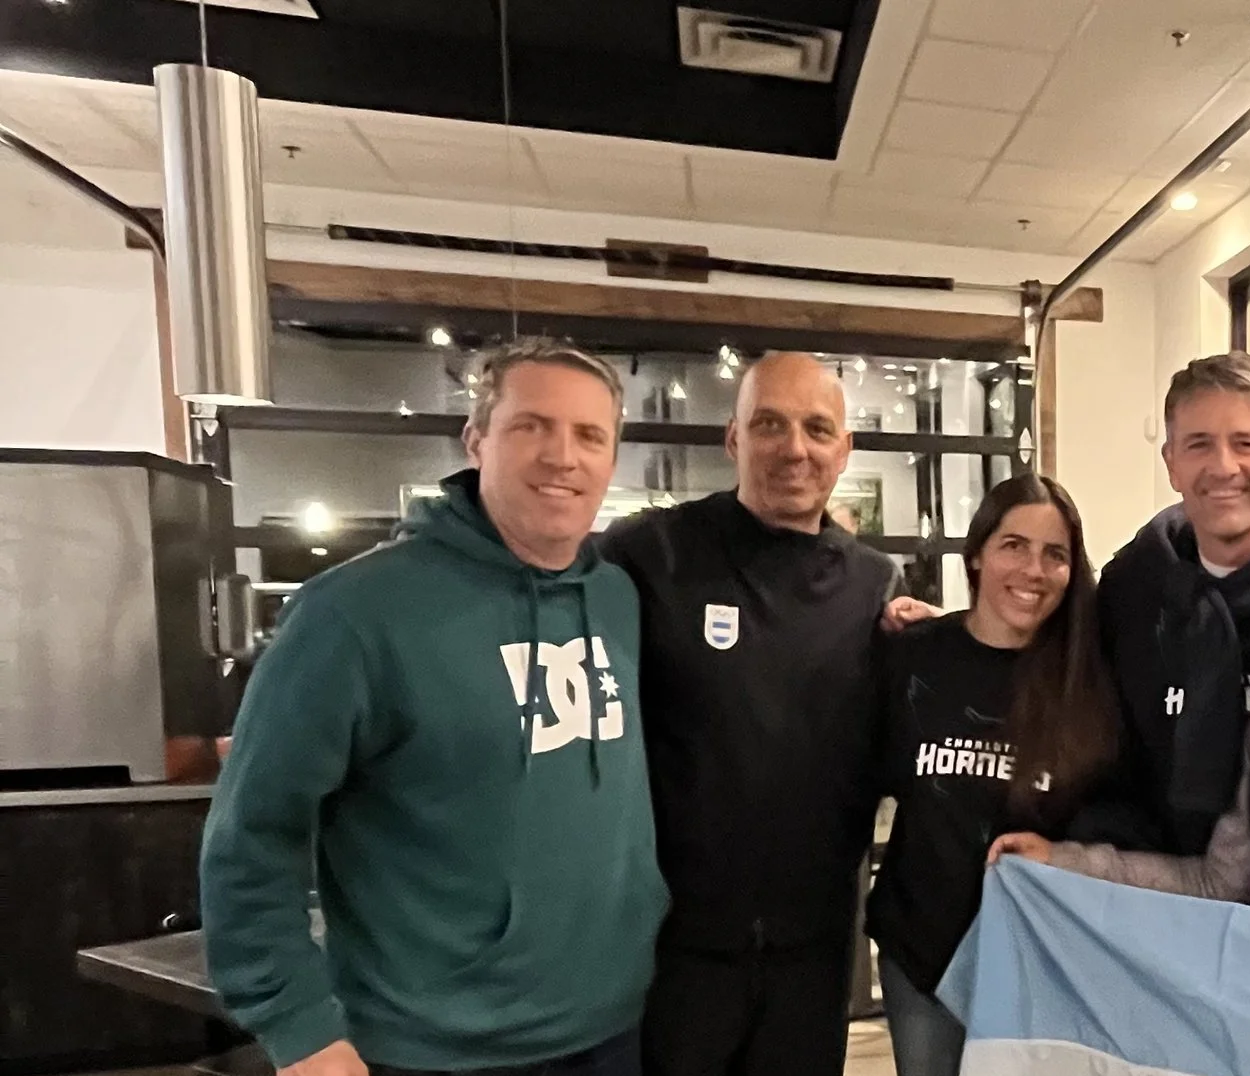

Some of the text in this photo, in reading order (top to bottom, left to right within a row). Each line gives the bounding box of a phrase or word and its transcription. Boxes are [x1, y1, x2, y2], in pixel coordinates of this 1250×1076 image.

[499, 636, 624, 755] DC
[916, 743, 1052, 793] HORNES
[944, 737, 1019, 754] CHARLOT
